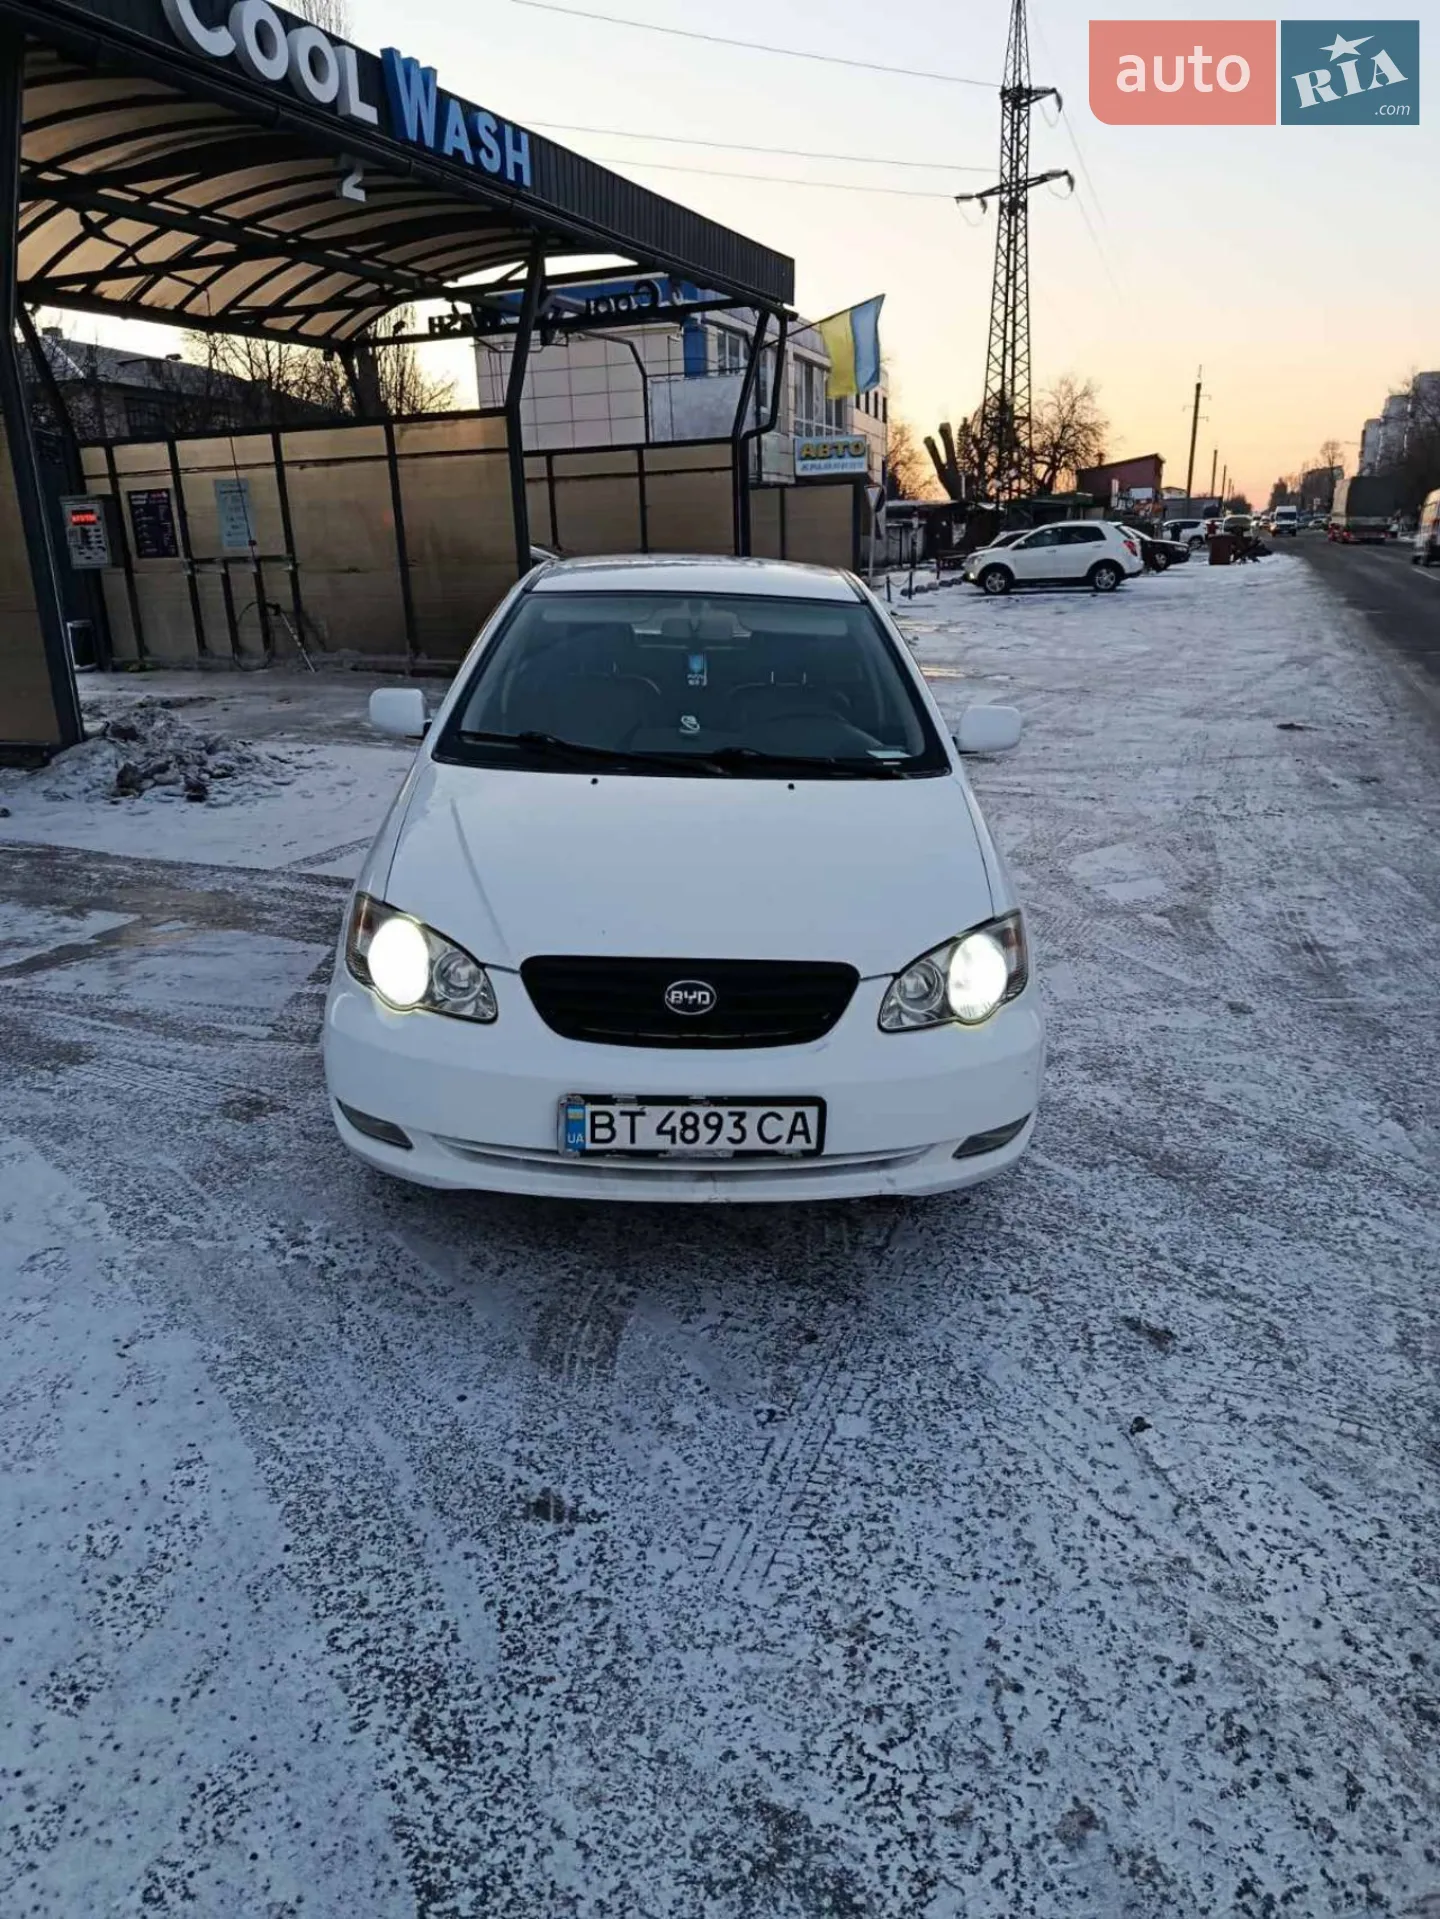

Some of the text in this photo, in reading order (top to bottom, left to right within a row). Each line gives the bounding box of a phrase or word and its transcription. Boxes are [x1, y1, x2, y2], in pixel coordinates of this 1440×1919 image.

[380, 47, 531, 188] WASH
[671, 990, 710, 1005] BYD
[567, 1133, 585, 1144] UA
[590, 1111, 812, 1145] BT 4893 CA
